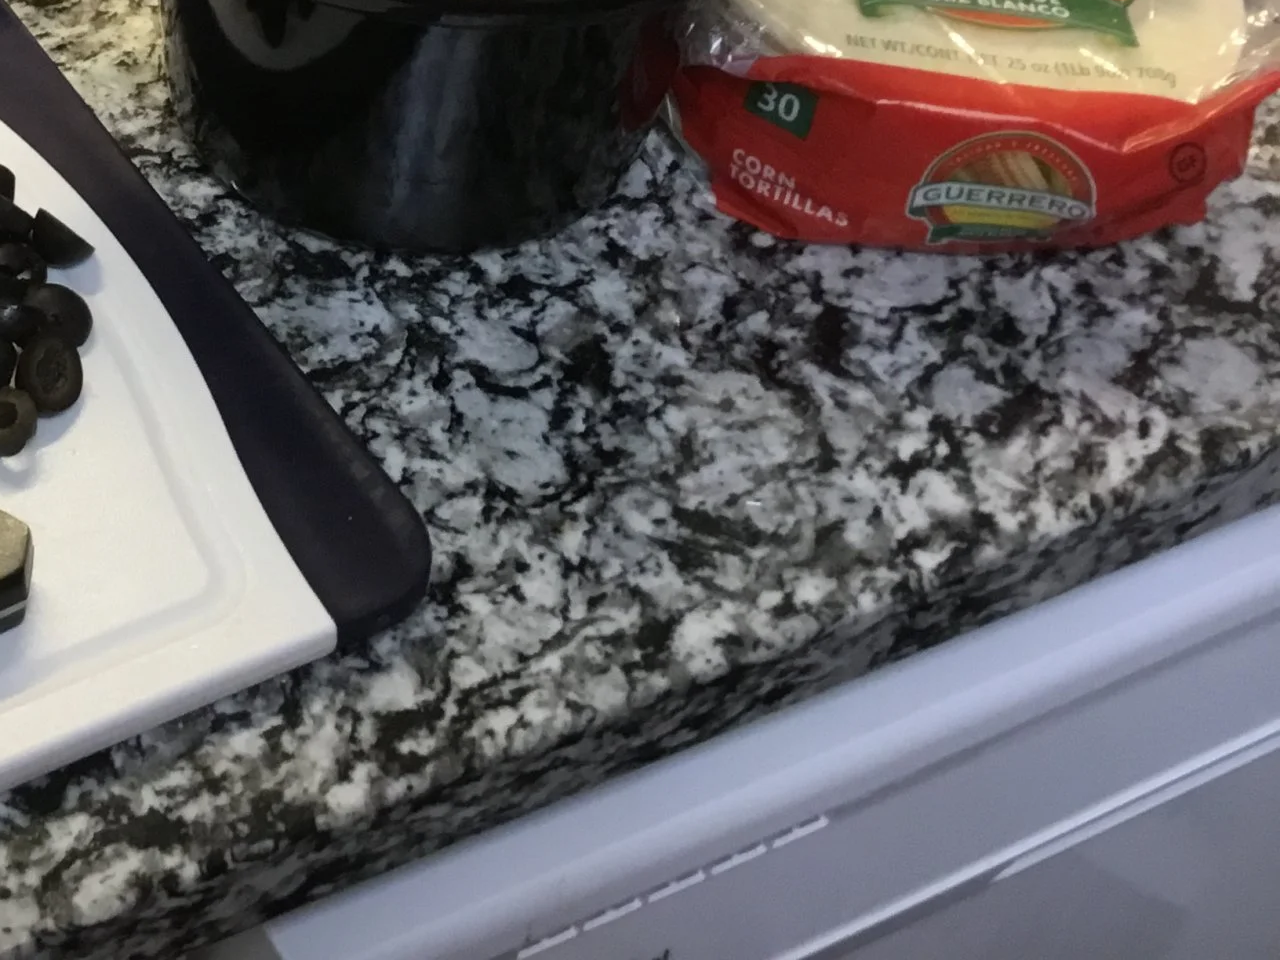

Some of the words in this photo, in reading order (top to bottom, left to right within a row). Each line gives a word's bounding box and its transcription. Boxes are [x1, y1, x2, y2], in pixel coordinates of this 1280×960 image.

[846, 33, 877, 49] NET
[1007, 56, 1027, 71] 25
[1030, 62, 1050, 74] oz
[756, 82, 801, 122] 30
[732, 148, 796, 189] CORN
[729, 163, 849, 227] TORTILLAS
[922, 185, 1087, 218] GUERRERO
